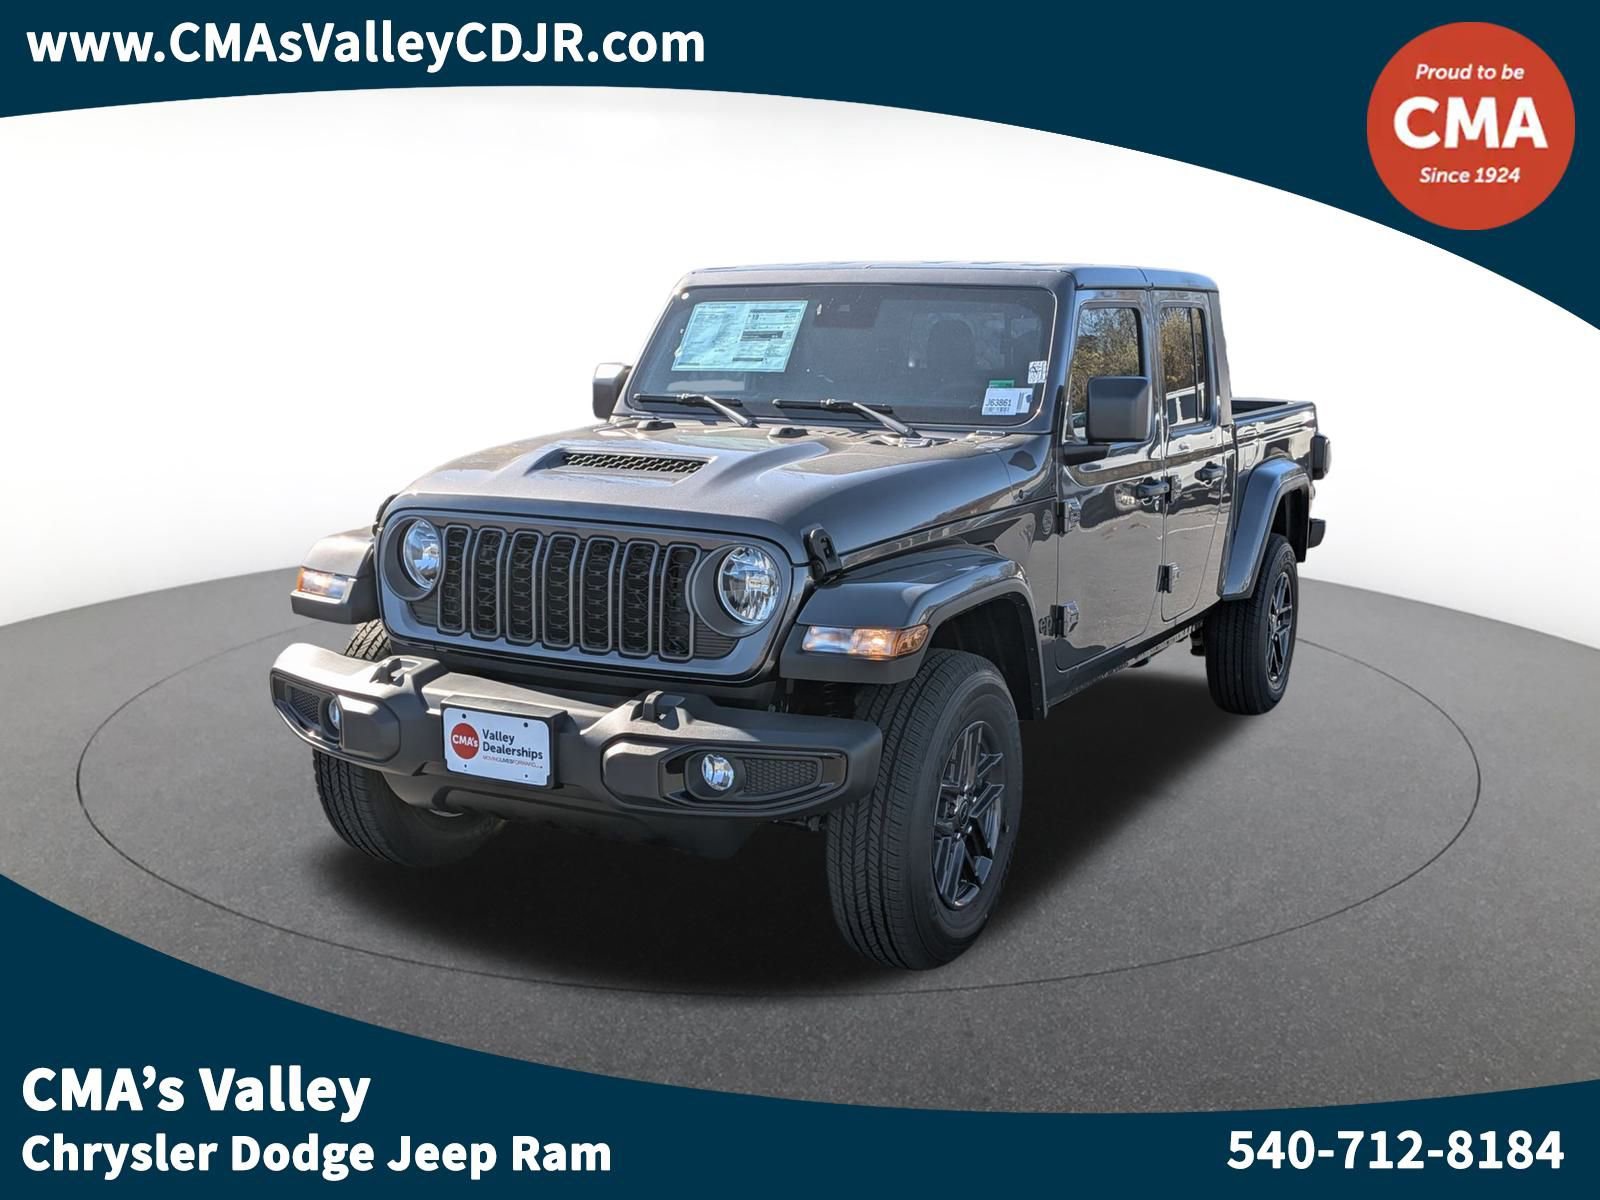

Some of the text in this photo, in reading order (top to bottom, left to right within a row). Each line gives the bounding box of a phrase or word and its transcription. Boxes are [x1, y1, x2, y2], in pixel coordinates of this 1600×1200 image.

[452, 734, 479, 748] CMA's
[482, 728, 515, 745] Valley
[482, 741, 543, 760] Dealerships
